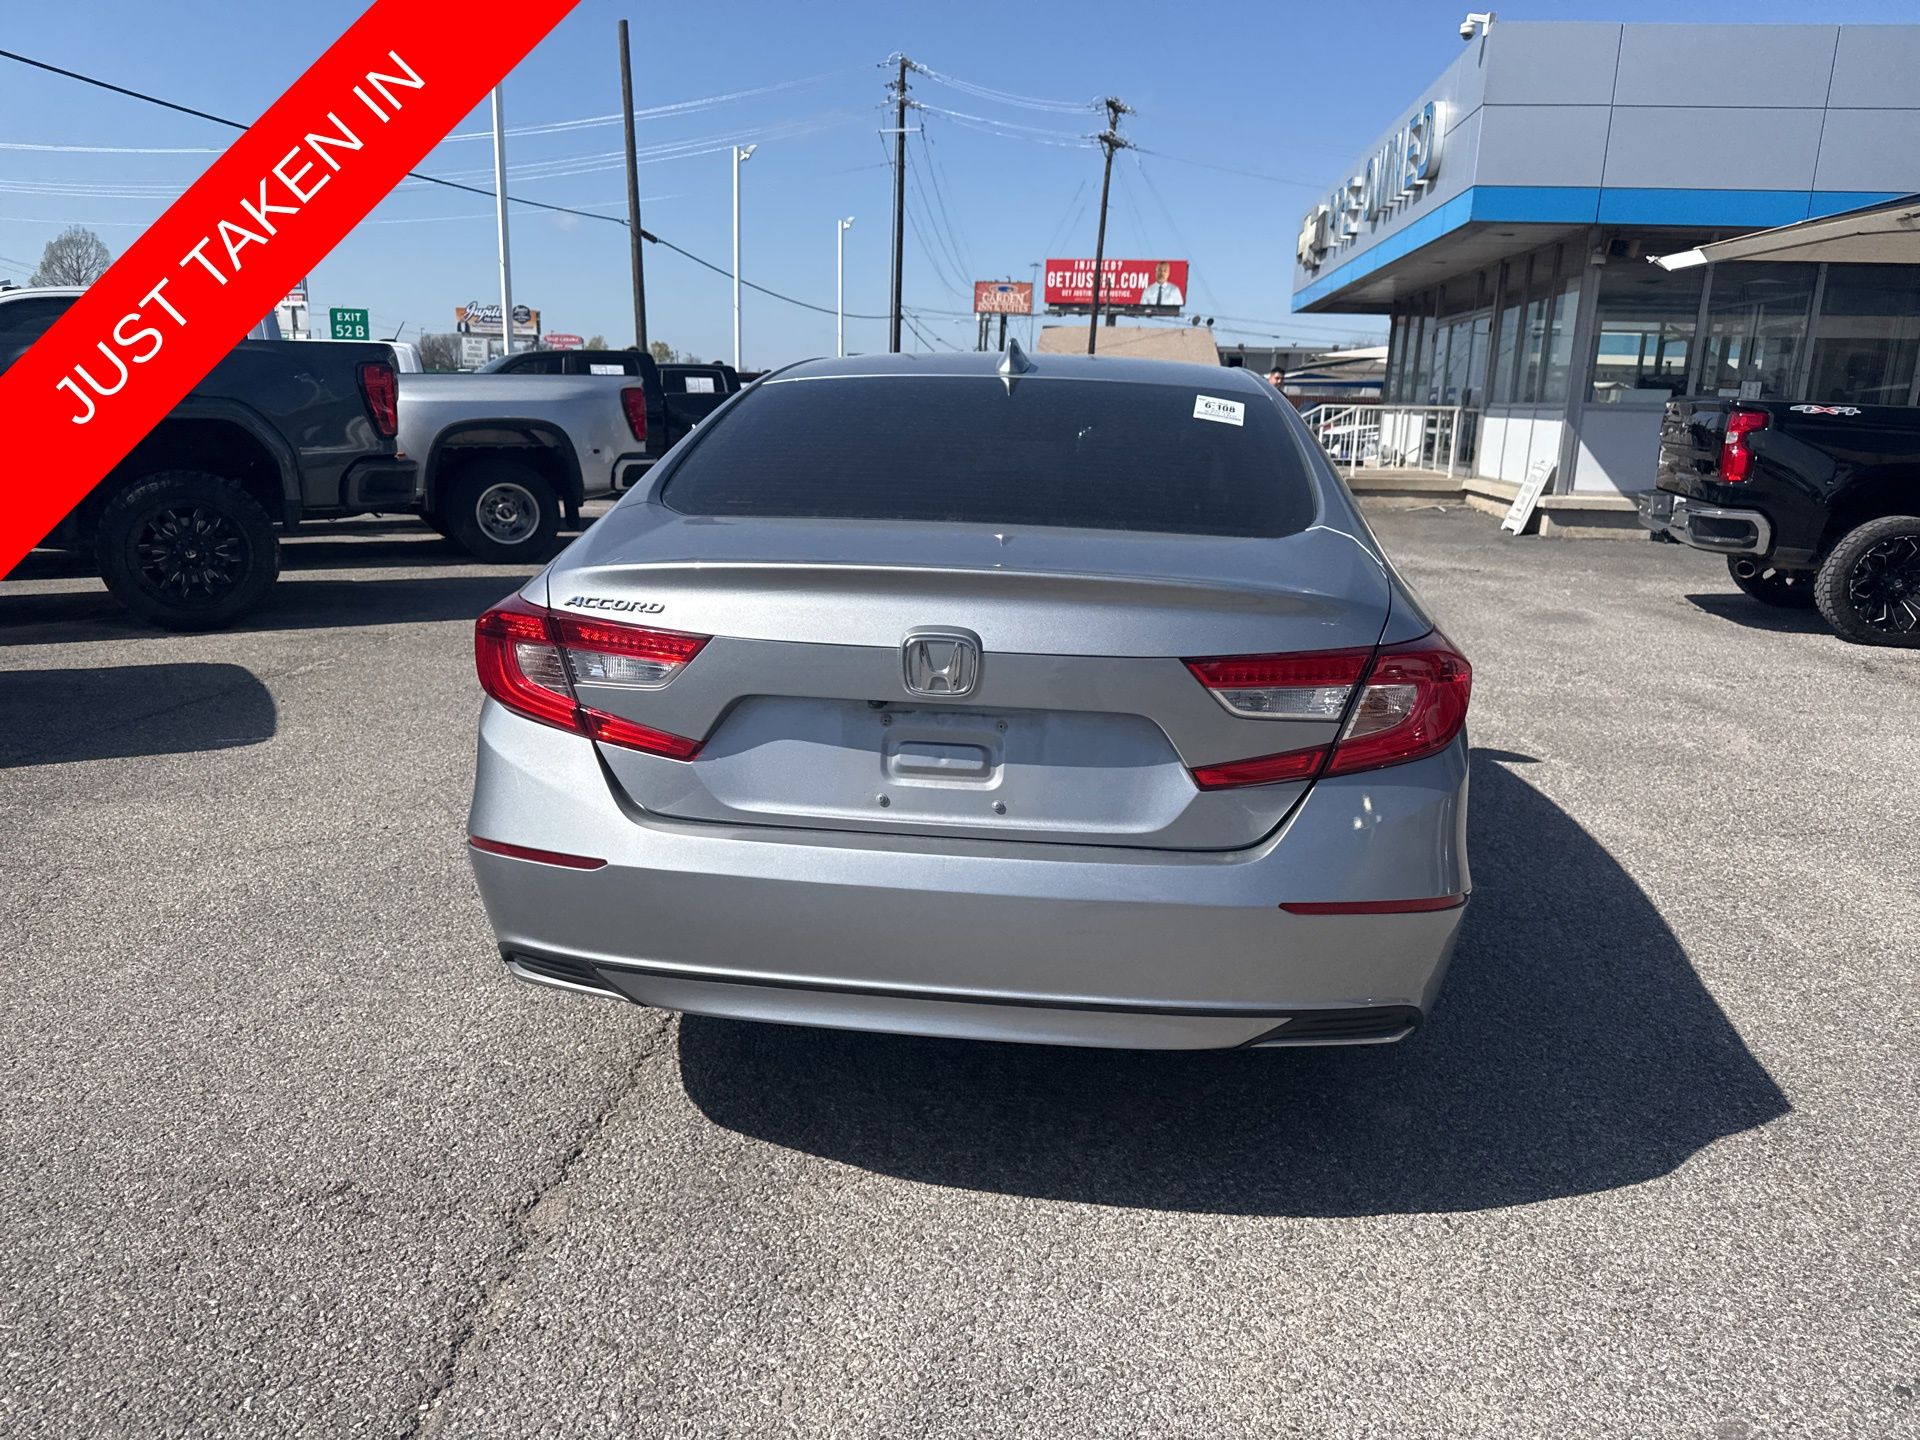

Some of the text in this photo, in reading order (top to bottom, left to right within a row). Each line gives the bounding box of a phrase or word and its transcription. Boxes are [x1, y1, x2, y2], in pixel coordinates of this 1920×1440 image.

[1047, 270, 1149, 289] GETJUSIN.COM
[336, 312, 362, 322] EXIT
[335, 325, 365, 338] 52 B
[563, 595, 666, 614] ACCORD
